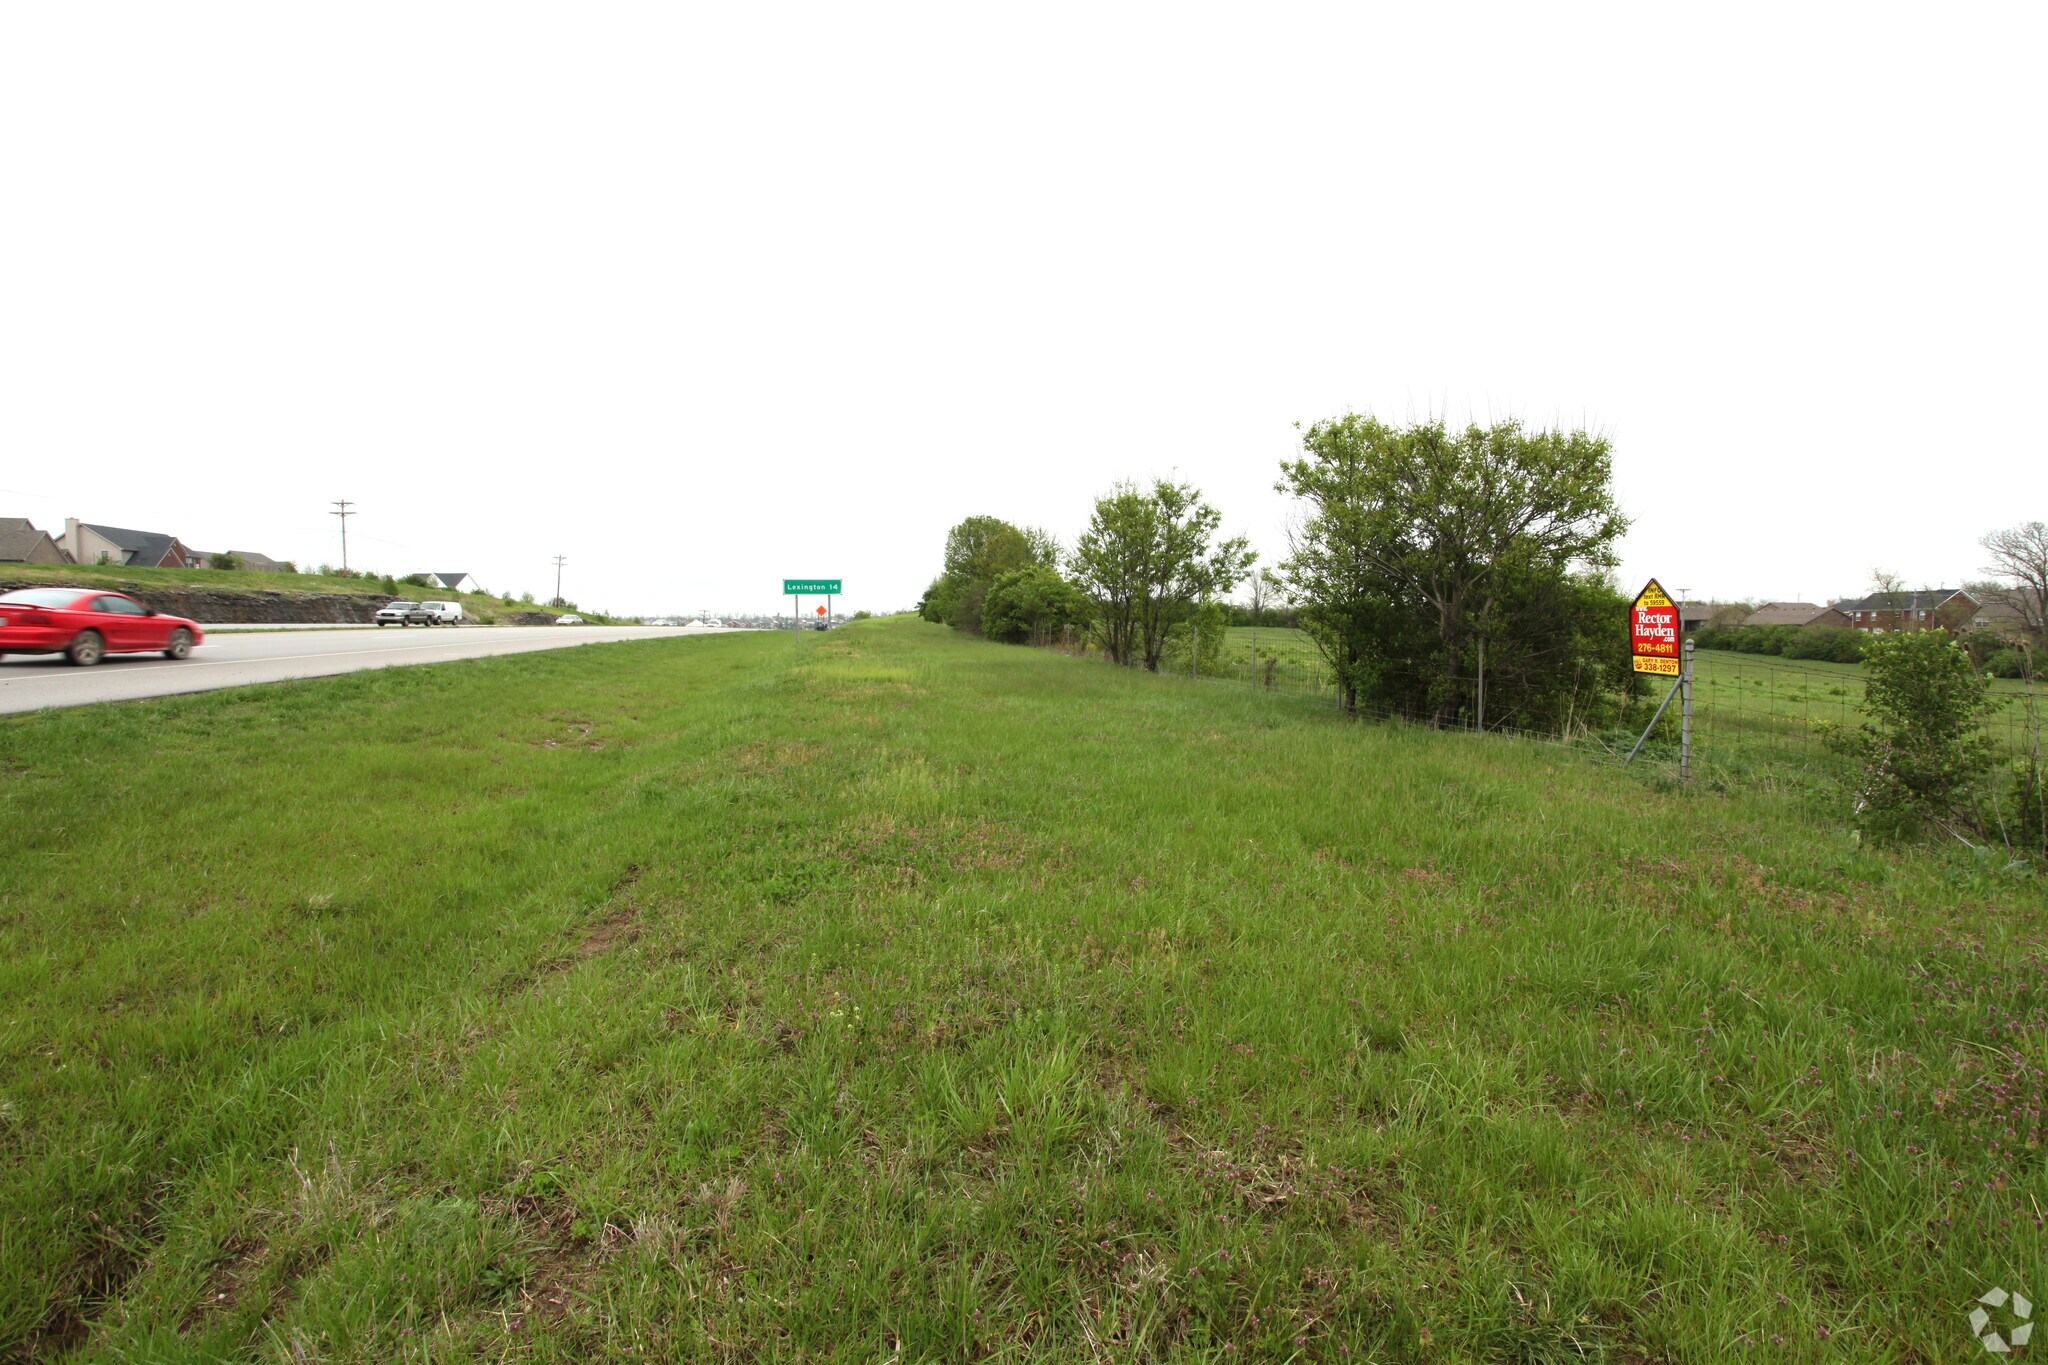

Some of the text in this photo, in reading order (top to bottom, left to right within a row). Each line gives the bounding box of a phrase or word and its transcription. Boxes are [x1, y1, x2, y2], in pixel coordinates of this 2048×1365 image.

[1638, 612, 1672, 623] Rector
[1635, 624, 1674, 640] Hayden
[1638, 643, 1672, 653] 276-4811
[1644, 663, 1676, 672] 338-1297
